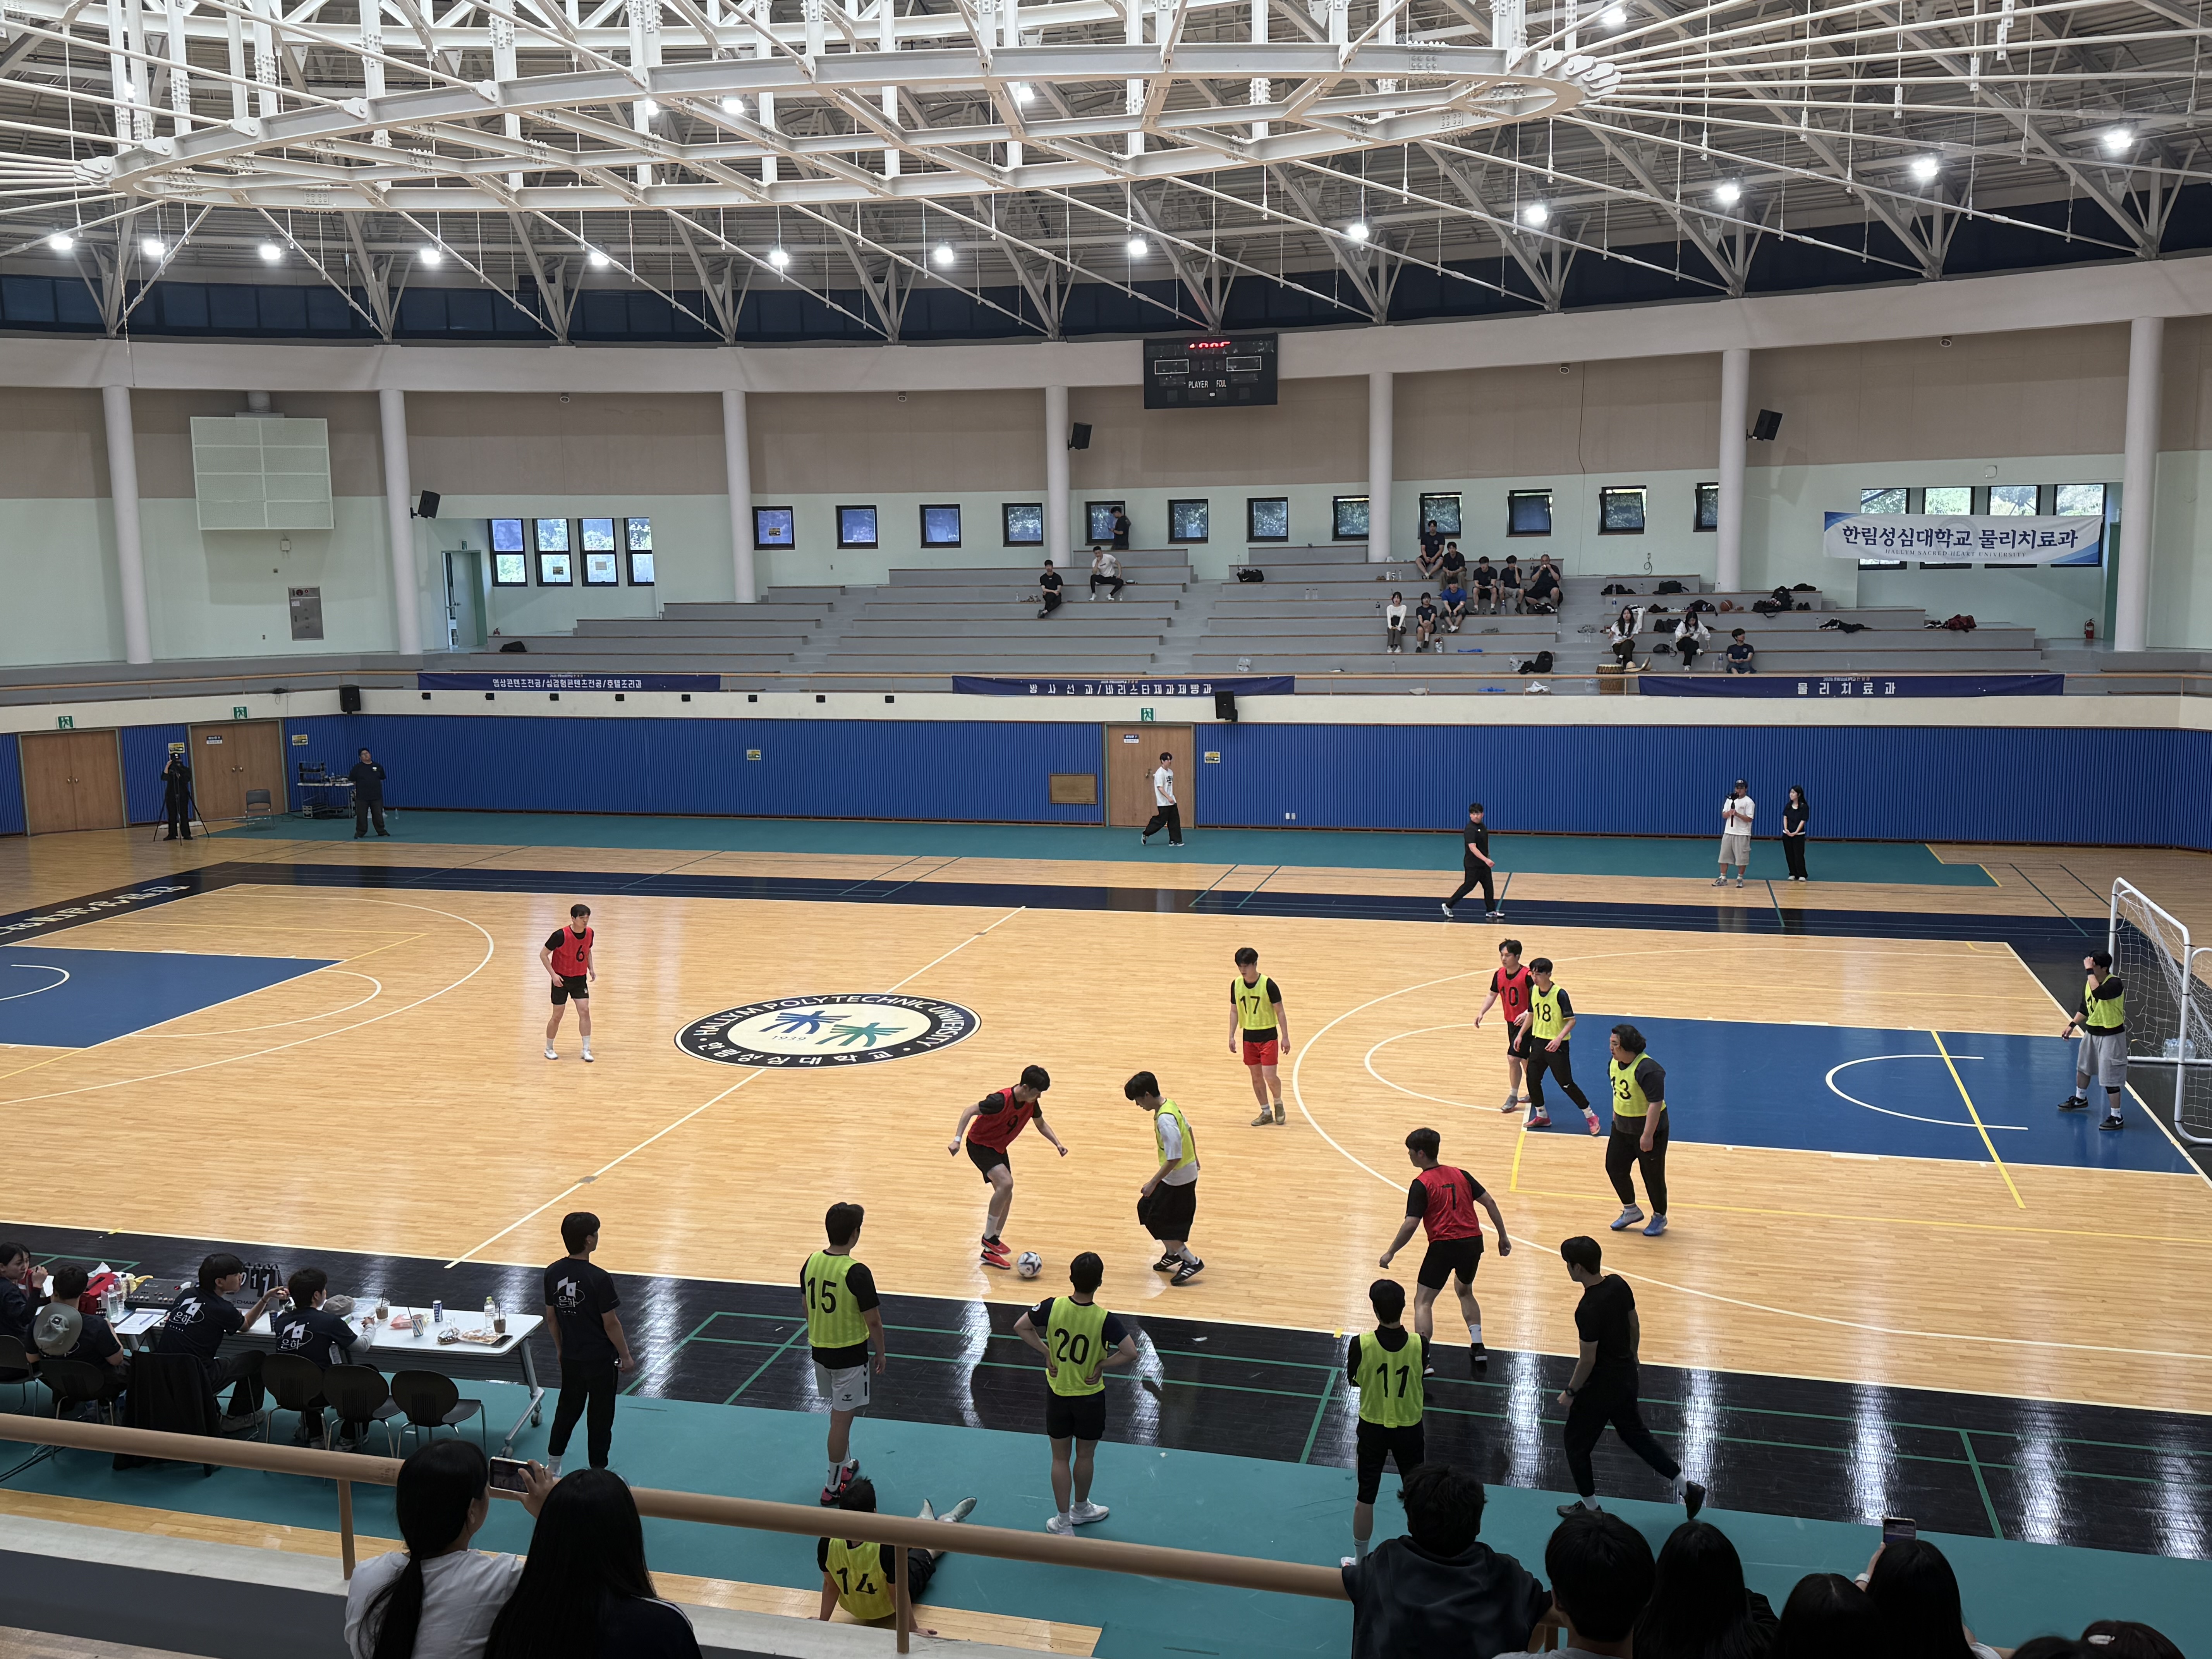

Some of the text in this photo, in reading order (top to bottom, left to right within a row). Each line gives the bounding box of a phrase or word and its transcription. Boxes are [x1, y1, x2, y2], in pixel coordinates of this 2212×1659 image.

[1188, 380, 1226, 388] PLAYER FOUL
[1842, 526, 2078, 549] 한림성심대학교 물리치료과
[0, 885, 190, 935] 한림성심대학
[575, 945, 585, 962] 6
[1240, 995, 1261, 1014] 17
[1501, 986, 1519, 1006] 10
[693, 995, 965, 1047] HALLYM POLYTECHNIC UNIVERSITY
[1535, 1002, 1551, 1022] 18
[698, 1042, 894, 1065] 한림성심대학교
[1611, 1076, 1632, 1100] 13
[1006, 1115, 1018, 1135] 9
[1440, 1182, 1457, 1211] 7
[807, 1277, 837, 1314] 15
[173, 1311, 193, 1325] 은하
[281, 1339, 302, 1350] 은하
[1054, 1328, 1089, 1365] 20
[1376, 1362, 1410, 1398] 11
[836, 1567, 878, 1595] 14
